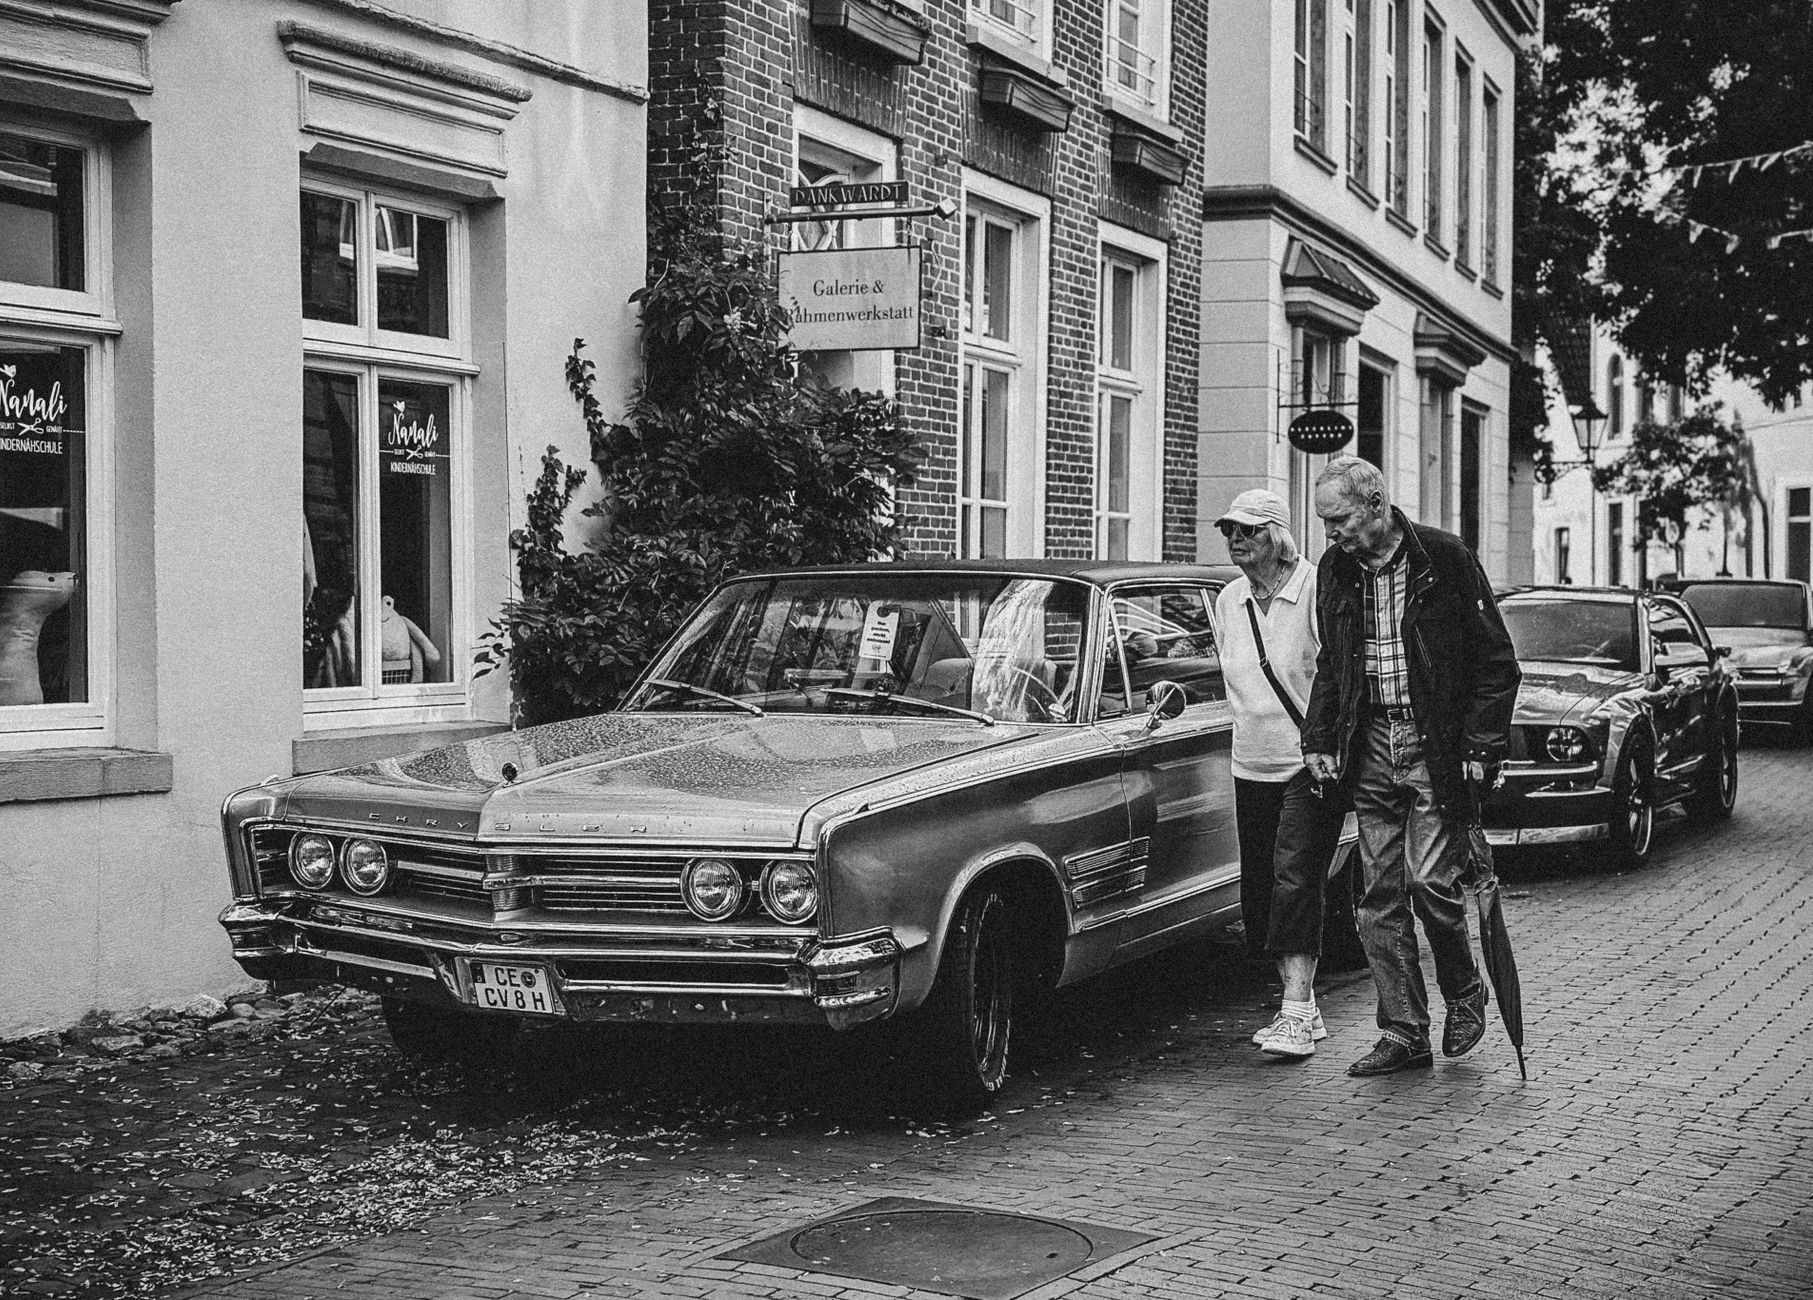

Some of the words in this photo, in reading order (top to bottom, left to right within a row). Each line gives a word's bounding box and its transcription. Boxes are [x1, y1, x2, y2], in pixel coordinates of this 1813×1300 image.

[795, 184, 902, 204] DANKWARDT
[813, 279, 868, 296] Galerie
[872, 280, 884, 294] &
[0, 379, 67, 421] Nanali
[388, 413, 439, 448] Nanali
[390, 461, 436, 475] KINDERNÄHSCHULE
[369, 812, 647, 833] CHRYSLER
[494, 967, 521, 987] CE
